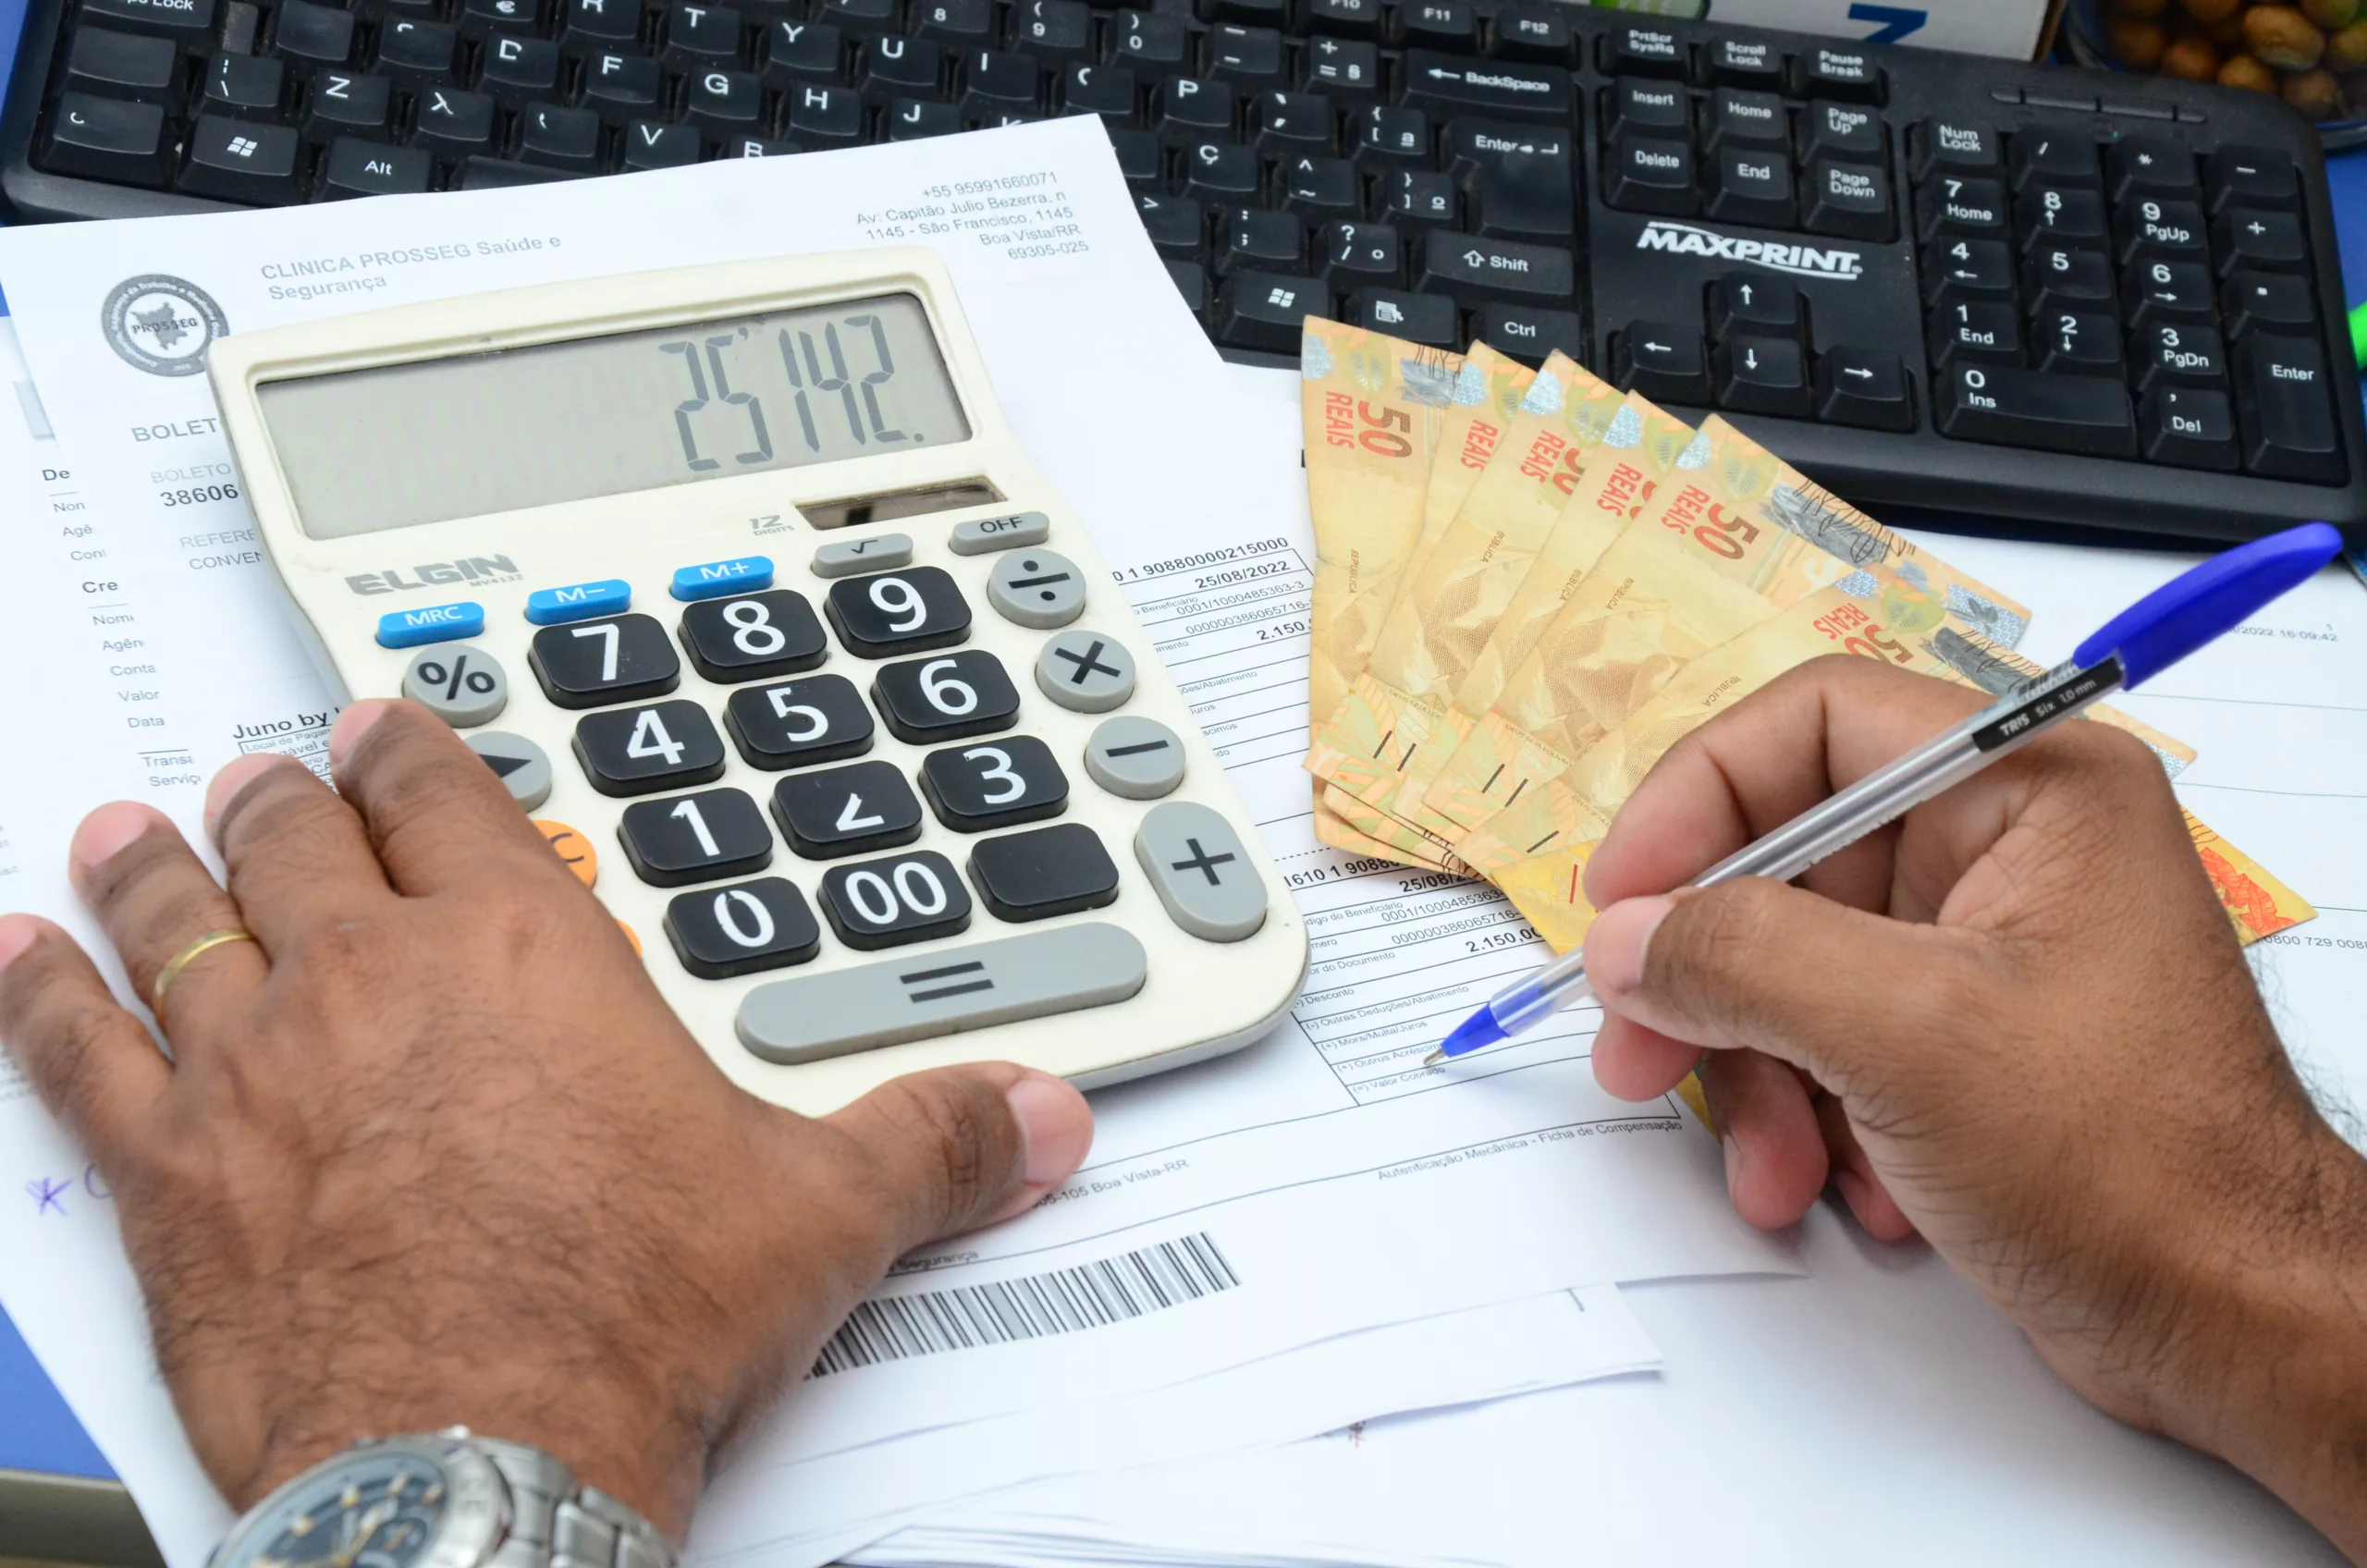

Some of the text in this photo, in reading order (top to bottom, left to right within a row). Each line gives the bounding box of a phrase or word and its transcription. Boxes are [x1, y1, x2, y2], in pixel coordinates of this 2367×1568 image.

[685, 7, 705, 28] T
[1424, 7, 1451, 20] F11
[783, 22, 803, 43] Y
[1520, 20, 1550, 34] F12
[1629, 30, 1674, 43] PrtScr
[882, 38, 903, 58] U
[1725, 42, 1766, 55] Scroll
[603, 55, 622, 75] F
[982, 53, 987, 71] I
[1727, 54, 1763, 67] Lock
[1820, 51, 1863, 66] Pause
[1820, 62, 1863, 77] Break
[325, 76, 350, 98] Z
[705, 74, 729, 94] G
[1178, 80, 1198, 98] P
[1466, 71, 1550, 92] BackSpace
[805, 88, 828, 110] H
[1633, 91, 1674, 105] Insert
[903, 104, 921, 123] J
[1728, 102, 1772, 119] Home
[1828, 107, 1868, 125] Page
[641, 125, 664, 145] V
[1829, 119, 1852, 134] Up
[1940, 125, 1979, 141] Num
[1476, 135, 1518, 152] Enter
[1941, 135, 1981, 152] Lock
[1200, 146, 1219, 165] Ç
[1635, 151, 1680, 168] Delete
[364, 160, 392, 176] Alt
[1738, 165, 1771, 179] End
[922, 171, 1058, 199] +55 95991660071
[1830, 169, 1870, 187] Page
[1830, 180, 1875, 198] Down
[1944, 179, 1962, 198] 7
[886, 203, 945, 222] Capitão
[950, 199, 985, 214] Julio
[1056, 191, 1066, 202] n
[2043, 191, 2062, 211] 8
[1947, 203, 1993, 222] Home
[2142, 202, 2161, 222] 9
[865, 228, 904, 240] 1145
[919, 221, 950, 235] São
[1036, 206, 1073, 221] 1145
[979, 223, 1082, 246] Boa Vista/RR
[2146, 224, 2189, 243] PgUp
[261, 235, 561, 280] CLINICA PROSSEG Saúde e
[1008, 240, 1089, 260] 69305-025
[1637, 225, 1861, 276] MAXPRINT
[1952, 242, 1970, 260] 4
[1490, 256, 1529, 273] Shift
[2052, 251, 2069, 271] 5
[2152, 264, 2171, 283] 6
[269, 275, 386, 300] Segurança
[1957, 305, 1968, 322] 1
[131, 318, 198, 334] PROSSEG
[1504, 322, 1536, 337] Ctrl
[2060, 316, 2078, 335] 2
[1960, 328, 1994, 345] End
[2161, 328, 2179, 347] 3
[2164, 349, 2209, 368] PgDn
[1965, 370, 1985, 388] 0
[2272, 364, 2314, 380] Enter
[1968, 392, 1996, 408] Ins
[1326, 391, 1355, 449] REAIS
[1358, 399, 1413, 458] 50
[2172, 416, 2201, 433] Del
[1461, 419, 1499, 472] REAIS
[1519, 429, 1567, 484] REAIS
[150, 463, 231, 484] BOLETO
[1597, 462, 1643, 517] REAIS
[1662, 484, 1711, 535] REAIS
[749, 514, 783, 531] 12
[753, 522, 794, 537] DIGITS
[979, 516, 1024, 534] OFF
[1694, 502, 1760, 560] 50
[344, 554, 519, 596] ELGIN
[699, 561, 751, 581] M+
[1129, 568, 1138, 579] 1
[1194, 560, 1291, 589] 25/08/2022
[81, 580, 119, 594] Cre
[867, 576, 928, 634] 9
[1141, 597, 1198, 615] Beneficiário
[405, 606, 463, 627] MRC
[1813, 602, 1870, 641] REAIS
[721, 599, 788, 657] 8
[570, 622, 621, 683] 7
[418, 655, 496, 702] %
[918, 658, 979, 717] 6
[117, 690, 160, 702] Valor
[128, 717, 166, 729] Data
[767, 687, 831, 744] 5
[1999, 713, 2030, 736] TRIS
[233, 720, 292, 740] Juno
[298, 713, 327, 727] by
[625, 708, 686, 766] 4
[964, 746, 1028, 805] 3
[668, 799, 722, 858] 1
[1331, 865, 1341, 876] 1
[845, 860, 949, 925] 00
[713, 888, 777, 949] 0
[1346, 900, 1404, 918] Beneficiário
[2263, 935, 2333, 947] 0800 729
[1338, 951, 1395, 969] Documento
[1306, 987, 1355, 1005] Desconto
[1320, 1013, 1356, 1026] Outras
[1357, 986, 1469, 1017] Deduções/Abatimento
[1338, 1021, 1428, 1047] Mora/Multa/Juros
[1355, 1054, 1391, 1068] Outros
[1370, 1076, 1398, 1089] Valor
[1400, 1066, 1445, 1083] Cobrado
[1378, 1120, 1683, 1181] Autenticação Mecânica Ficha de Compensação
[1091, 1178, 1122, 1194] Boa
[1122, 1158, 1189, 1184] Vista-RR
